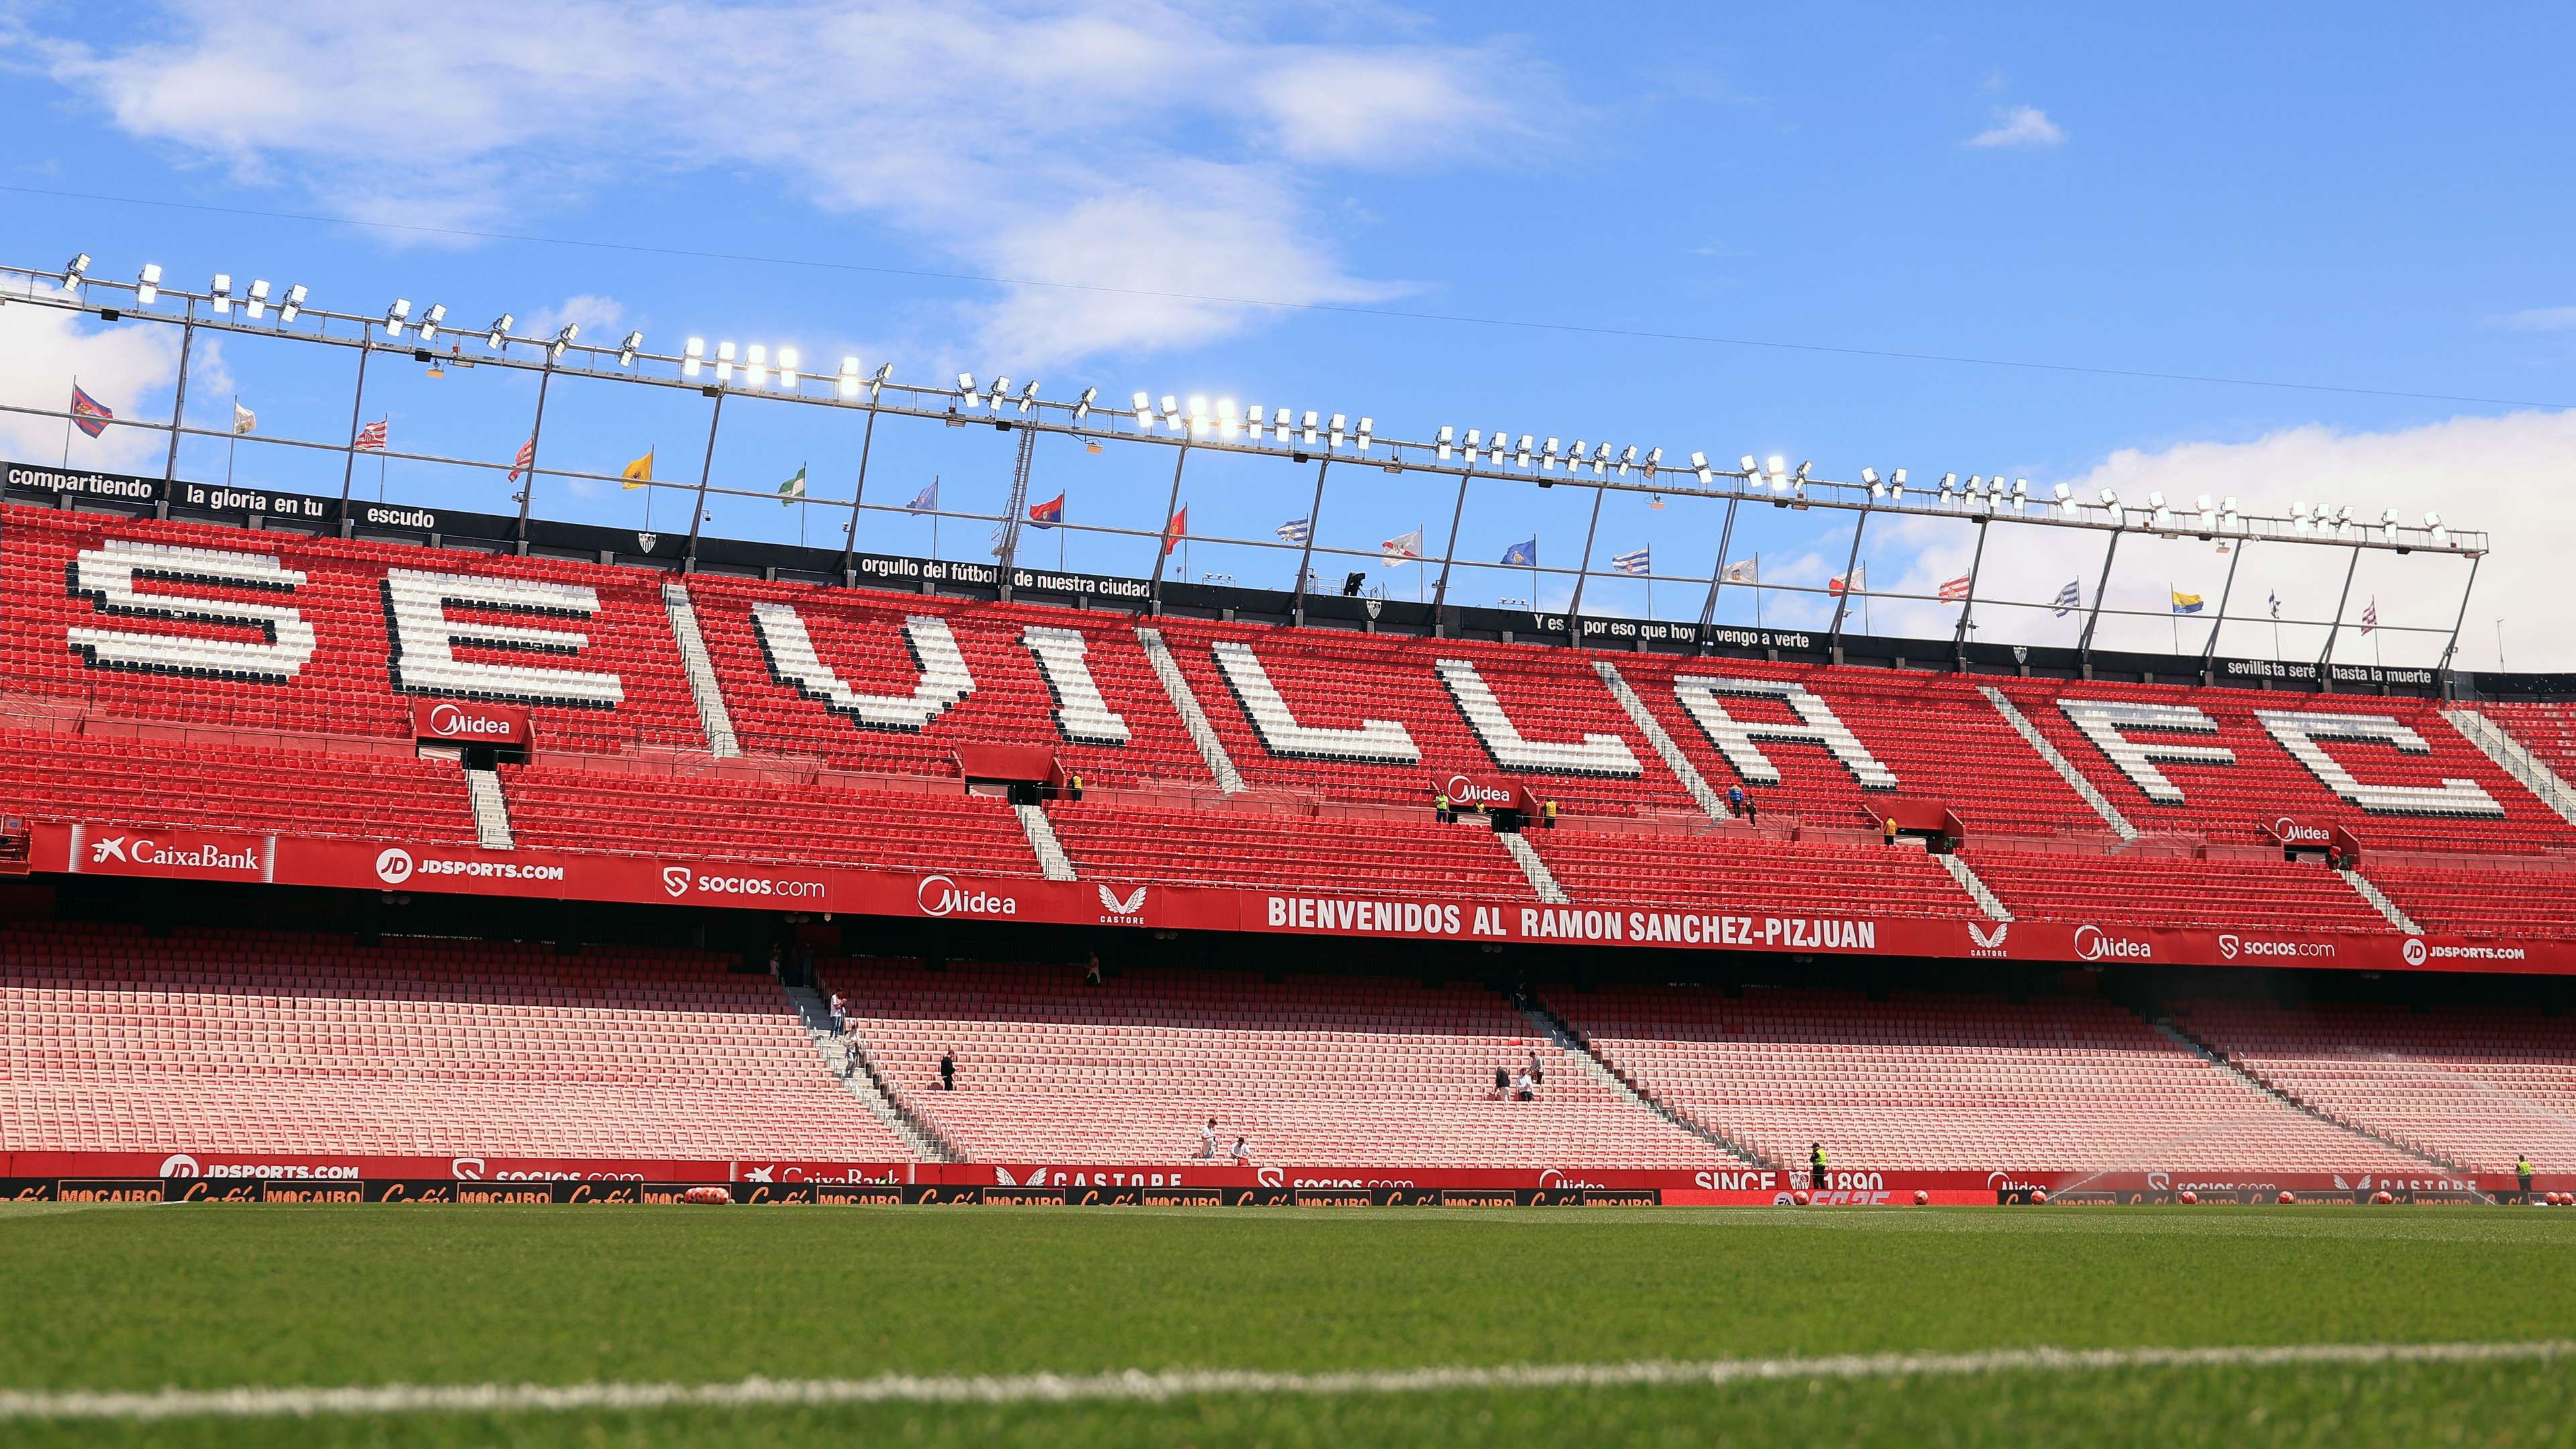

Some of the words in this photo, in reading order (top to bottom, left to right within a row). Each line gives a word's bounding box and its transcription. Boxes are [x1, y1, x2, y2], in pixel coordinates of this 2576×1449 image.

[9, 468, 152, 498] compartiendo
[187, 484, 204, 504] la
[211, 488, 266, 511] gloria
[275, 498, 298, 513] en
[304, 498, 323, 517] tu
[368, 508, 435, 528] escudo
[862, 558, 918, 578] orgullo
[923, 561, 947, 578] del
[951, 563, 997, 583] fútbol
[1014, 570, 1033, 587] de
[1038, 576, 1095, 593] nuestra
[1100, 578, 1150, 598] ciudad
[1534, 614, 1544, 629] Y
[1548, 618, 1564, 631] es
[1584, 621, 1607, 637] por
[1611, 623, 1636, 636] eso
[1642, 625, 1667, 641] que
[1671, 624, 1696, 643] hoy
[1717, 631, 1758, 647] vengo
[1762, 633, 1770, 645] a
[1775, 633, 1809, 648] verte
[67, 539, 1900, 790] SEVILLA
[2056, 698, 2505, 818] FC
[2229, 661, 2286, 677] sevillista
[2288, 663, 2316, 678] seré
[2332, 665, 2368, 681] hasta
[2371, 667, 2383, 682] la
[2387, 669, 2432, 684] muerte
[430, 714, 510, 735] Midea
[1448, 784, 1509, 803] Midea
[2276, 825, 2330, 842] Midea
[131, 840, 259, 869] CaixaBank
[417, 859, 564, 881] JDSPORTS.COM
[918, 889, 1016, 916] Midea
[1100, 916, 1144, 924] CASTORE
[1269, 896, 1460, 934] BIENVENIDOS
[1473, 906, 1507, 936] AL
[1521, 908, 1621, 940] RAMON
[1629, 912, 1876, 949] SANCHEZ-PIZJUAN
[2074, 936, 2151, 960] Midea
[2429, 946, 2525, 960] JDSPORTS.COM
[203, 1165, 359, 1179] JDSPORTS.COM
[1695, 1171, 1776, 1190] SINCE
